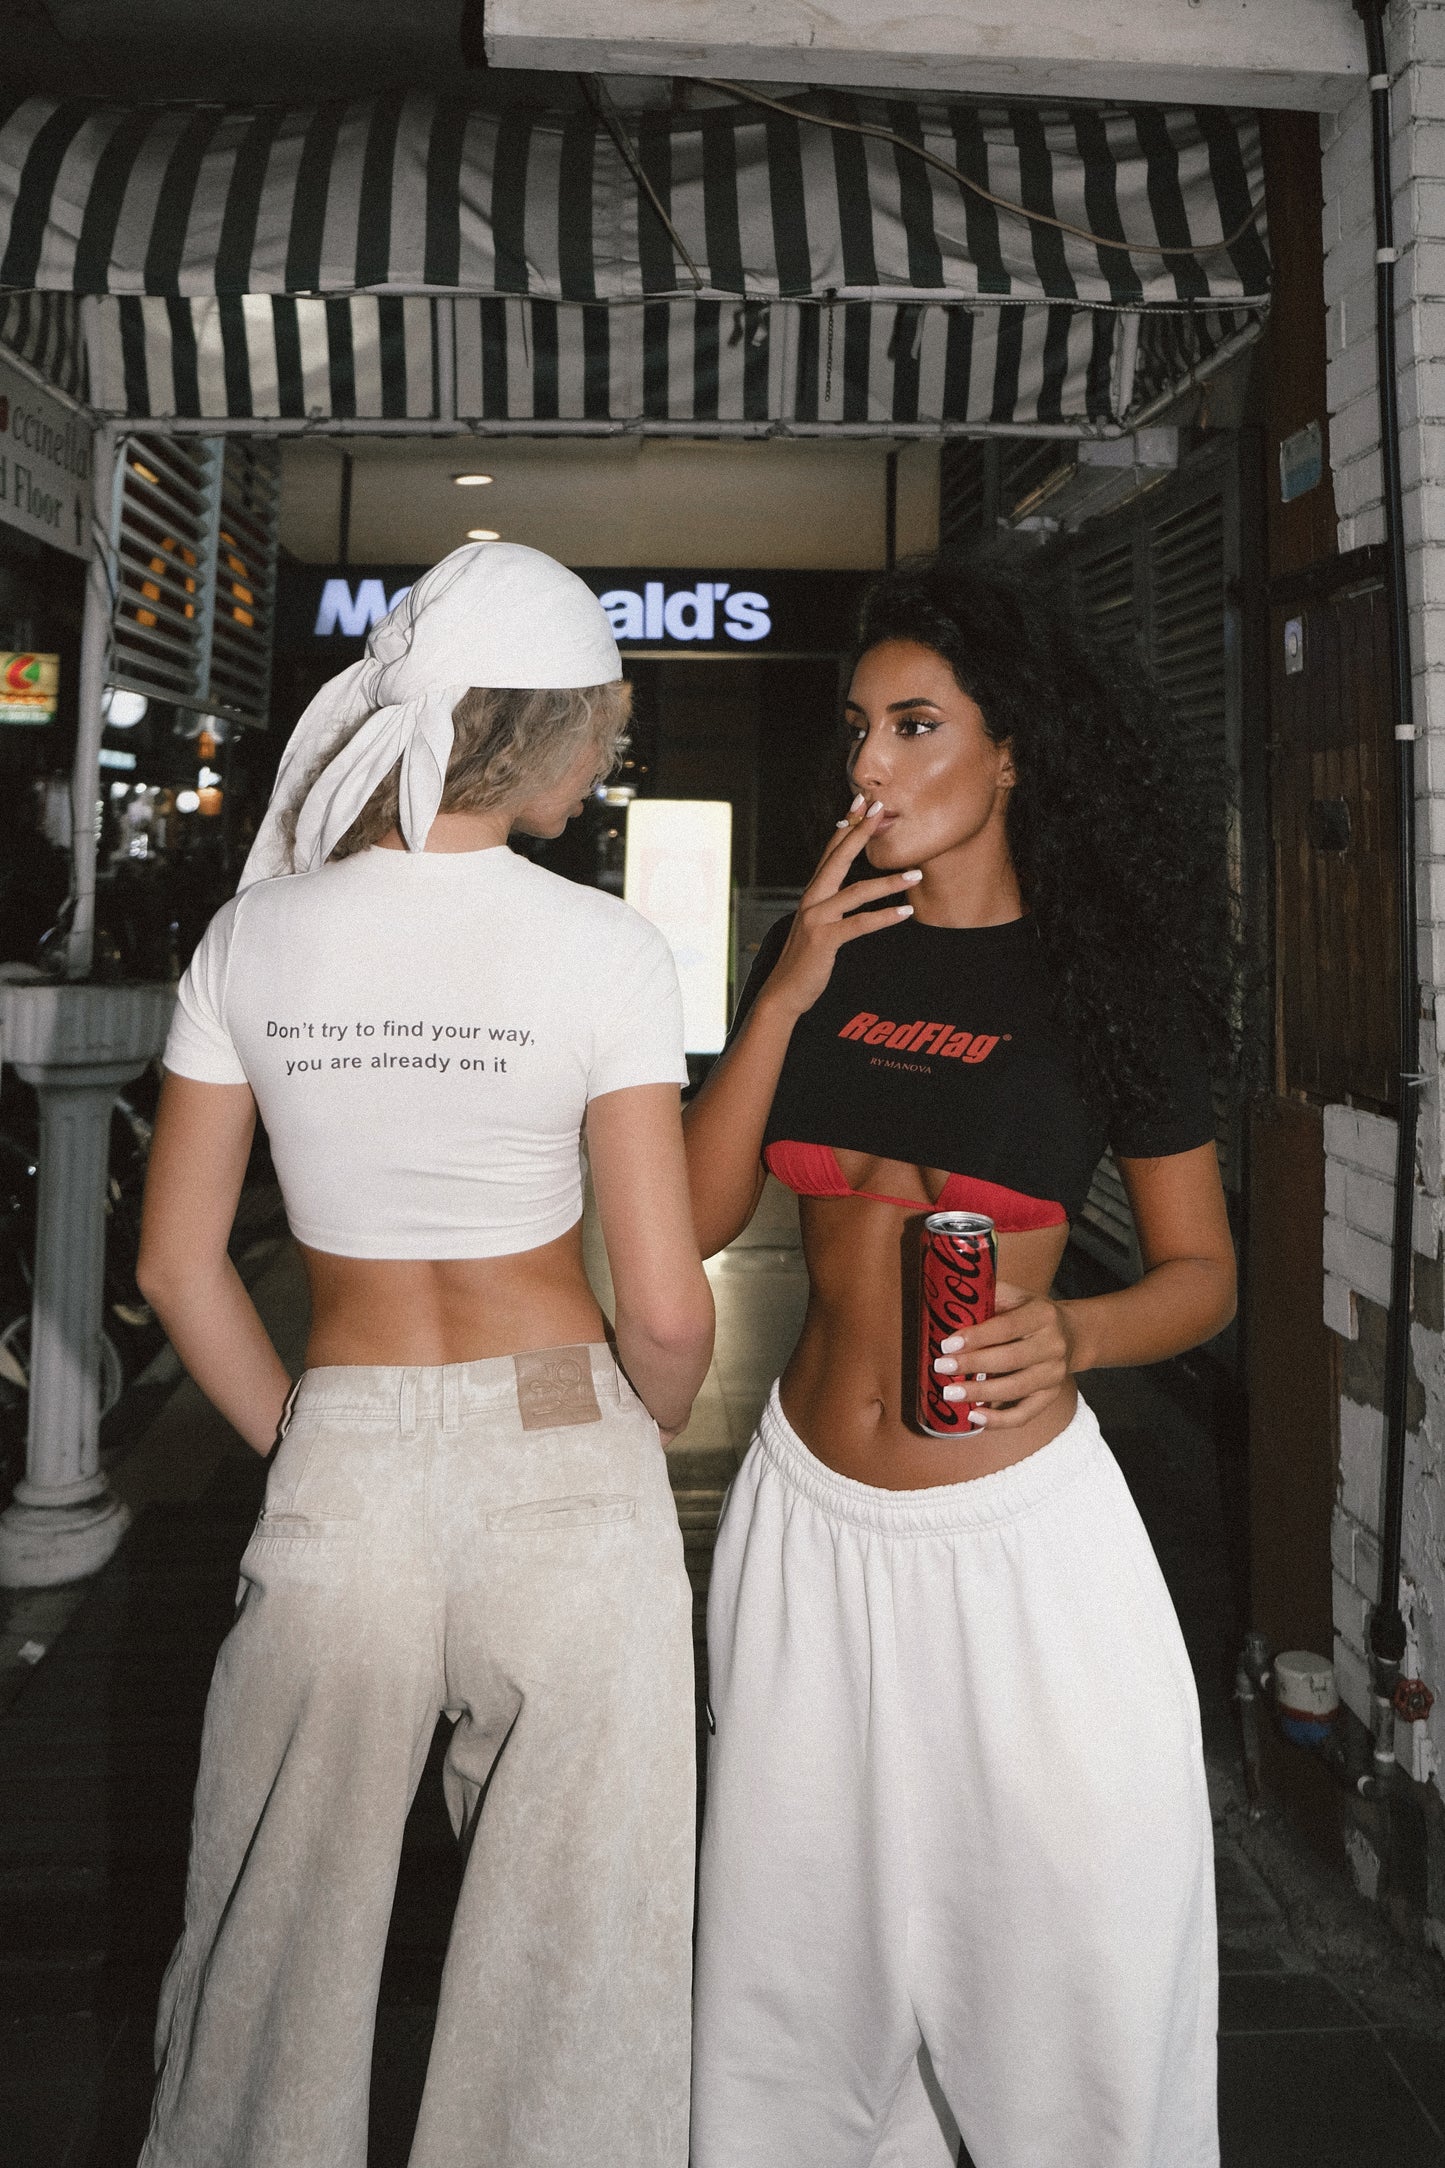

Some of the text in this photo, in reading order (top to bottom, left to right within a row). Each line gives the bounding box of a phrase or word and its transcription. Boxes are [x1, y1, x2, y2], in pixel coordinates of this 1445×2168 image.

[314, 578, 772, 642] Mald's
[266, 1020, 535, 1047] Don't try to find your way,
[285, 1052, 507, 1076] you are already on it
[884, 1060, 932, 1074] MANOVA
